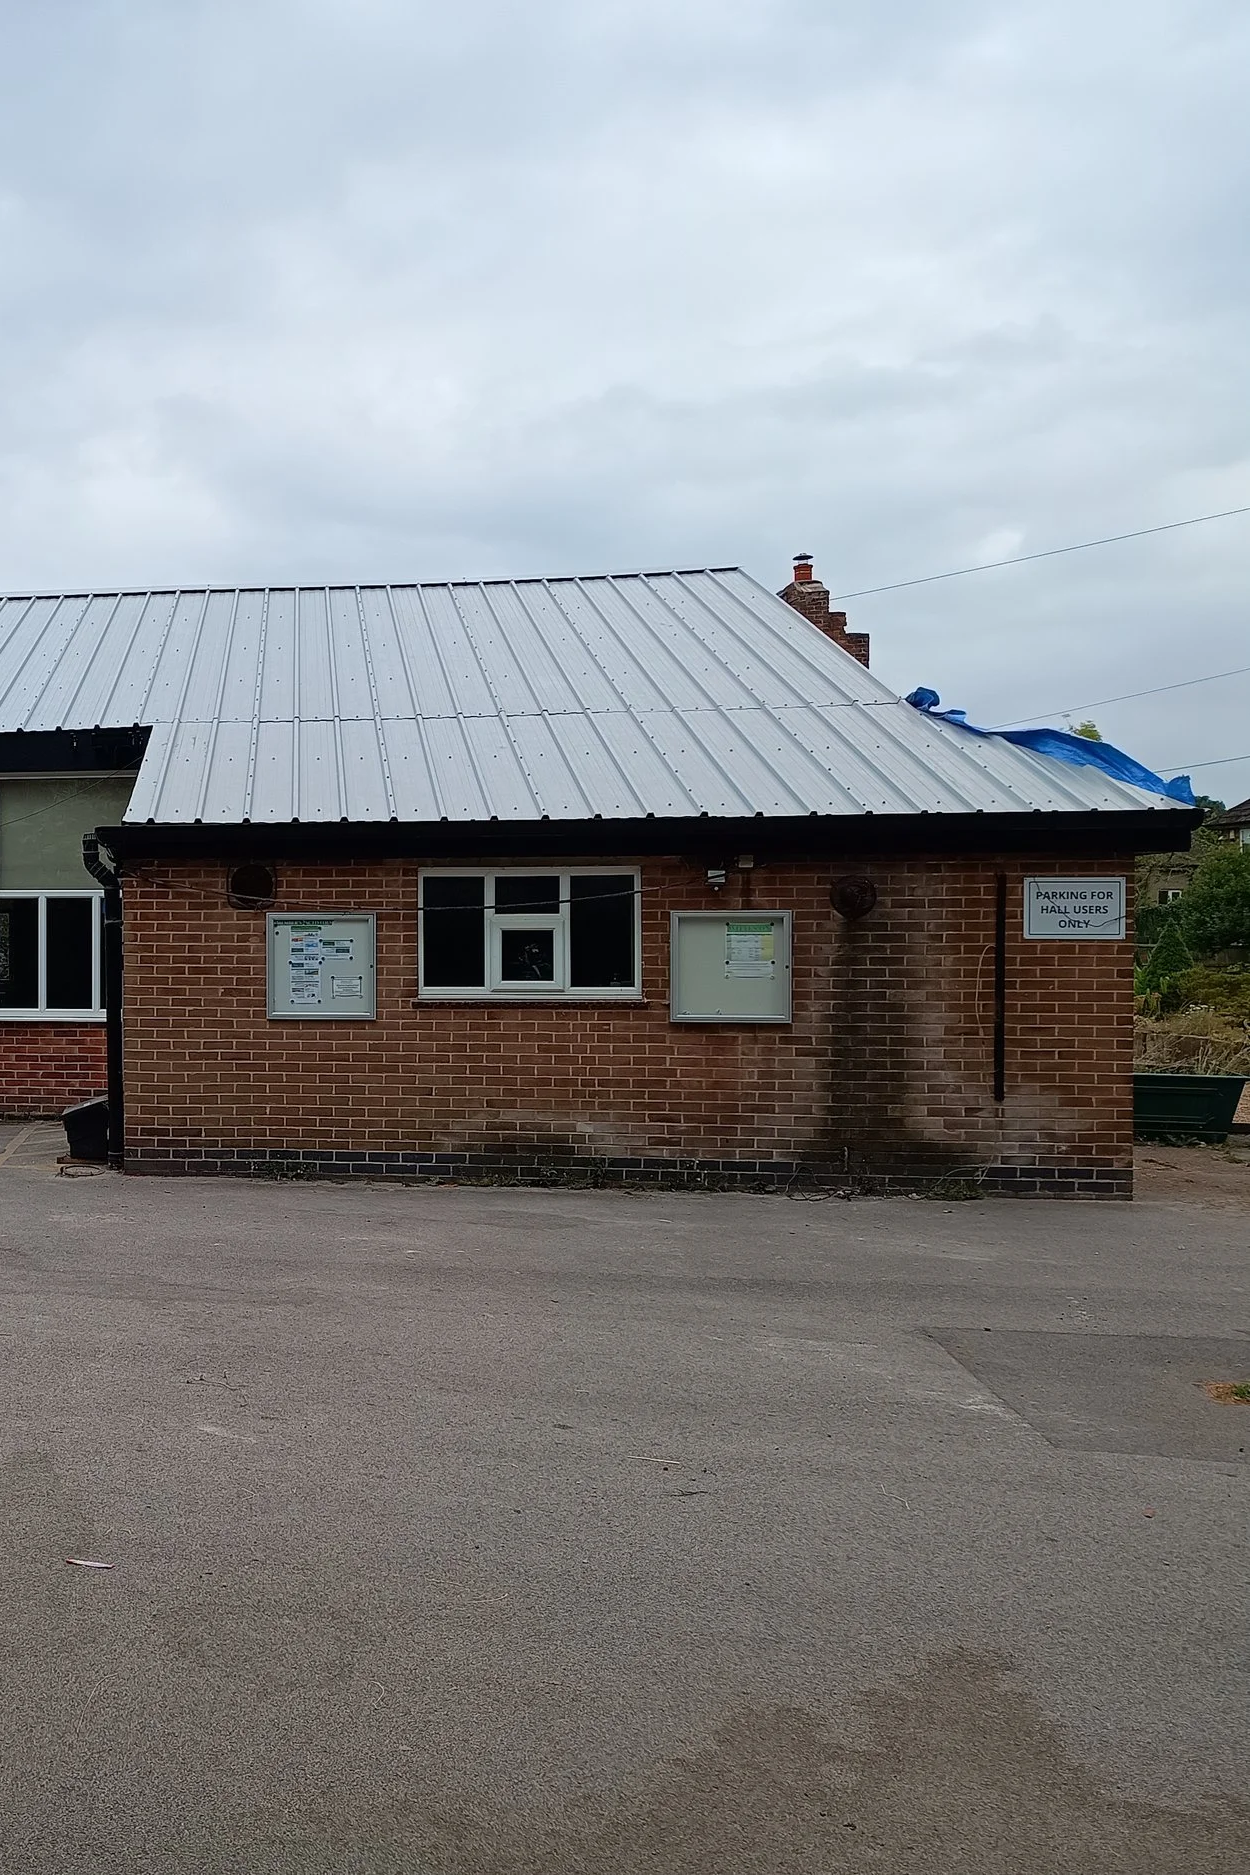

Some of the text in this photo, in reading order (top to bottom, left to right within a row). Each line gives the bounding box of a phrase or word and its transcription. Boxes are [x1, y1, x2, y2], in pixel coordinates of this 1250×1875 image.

[1036, 891, 1114, 900] PARKING FOR
[1040, 905, 1109, 914] HALL USERS
[1058, 919, 1091, 929] ONLY
